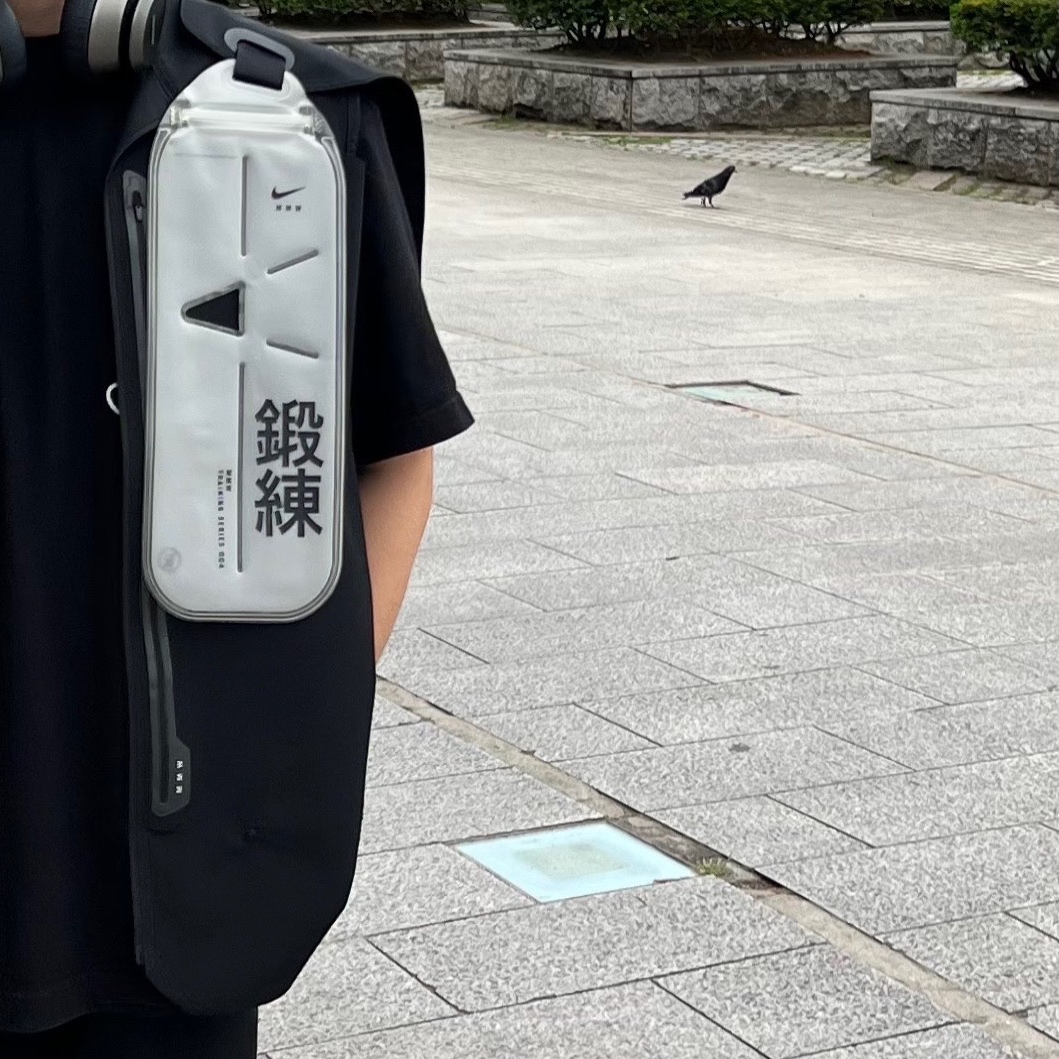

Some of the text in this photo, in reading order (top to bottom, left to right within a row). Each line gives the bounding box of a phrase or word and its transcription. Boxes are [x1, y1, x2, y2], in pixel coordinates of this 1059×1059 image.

[254, 398, 325, 538] 鍛練
[217, 469, 225, 512] TRAINING
[217, 516, 225, 548] SERIES
